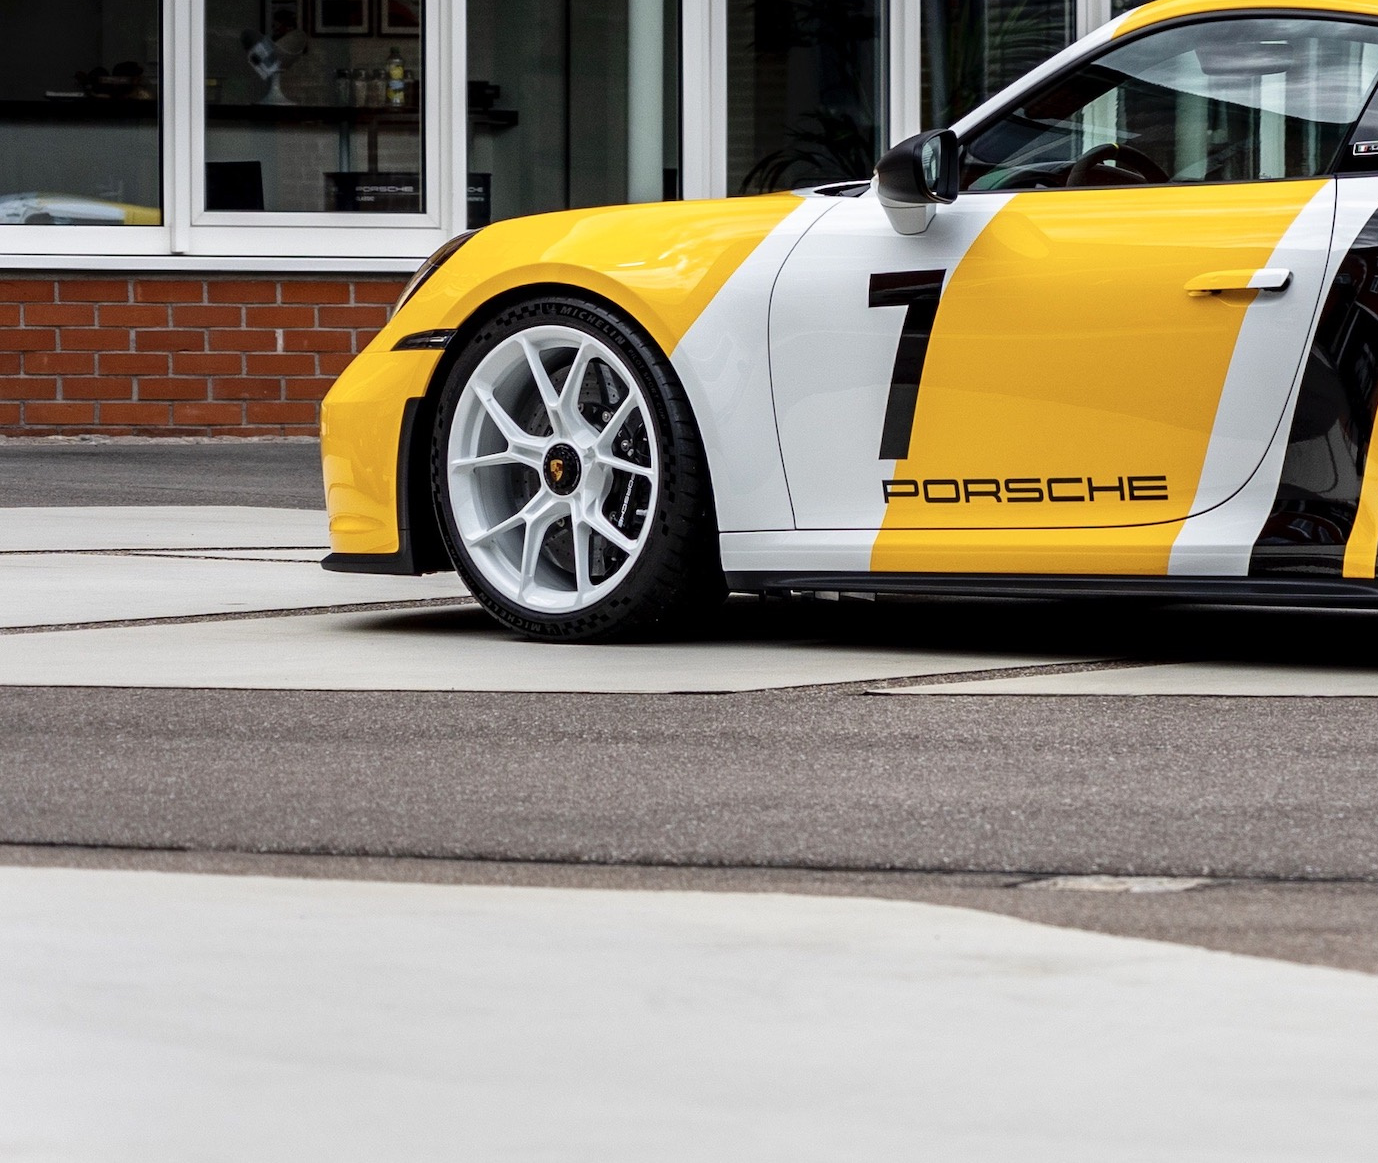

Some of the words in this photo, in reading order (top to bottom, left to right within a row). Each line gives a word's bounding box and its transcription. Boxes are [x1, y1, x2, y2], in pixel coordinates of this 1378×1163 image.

[559, 305, 626, 345] MICHELIN
[868, 268, 947, 460] 7
[881, 475, 1169, 504] PORSCHE
[479, 591, 540, 631] MICHELIN
